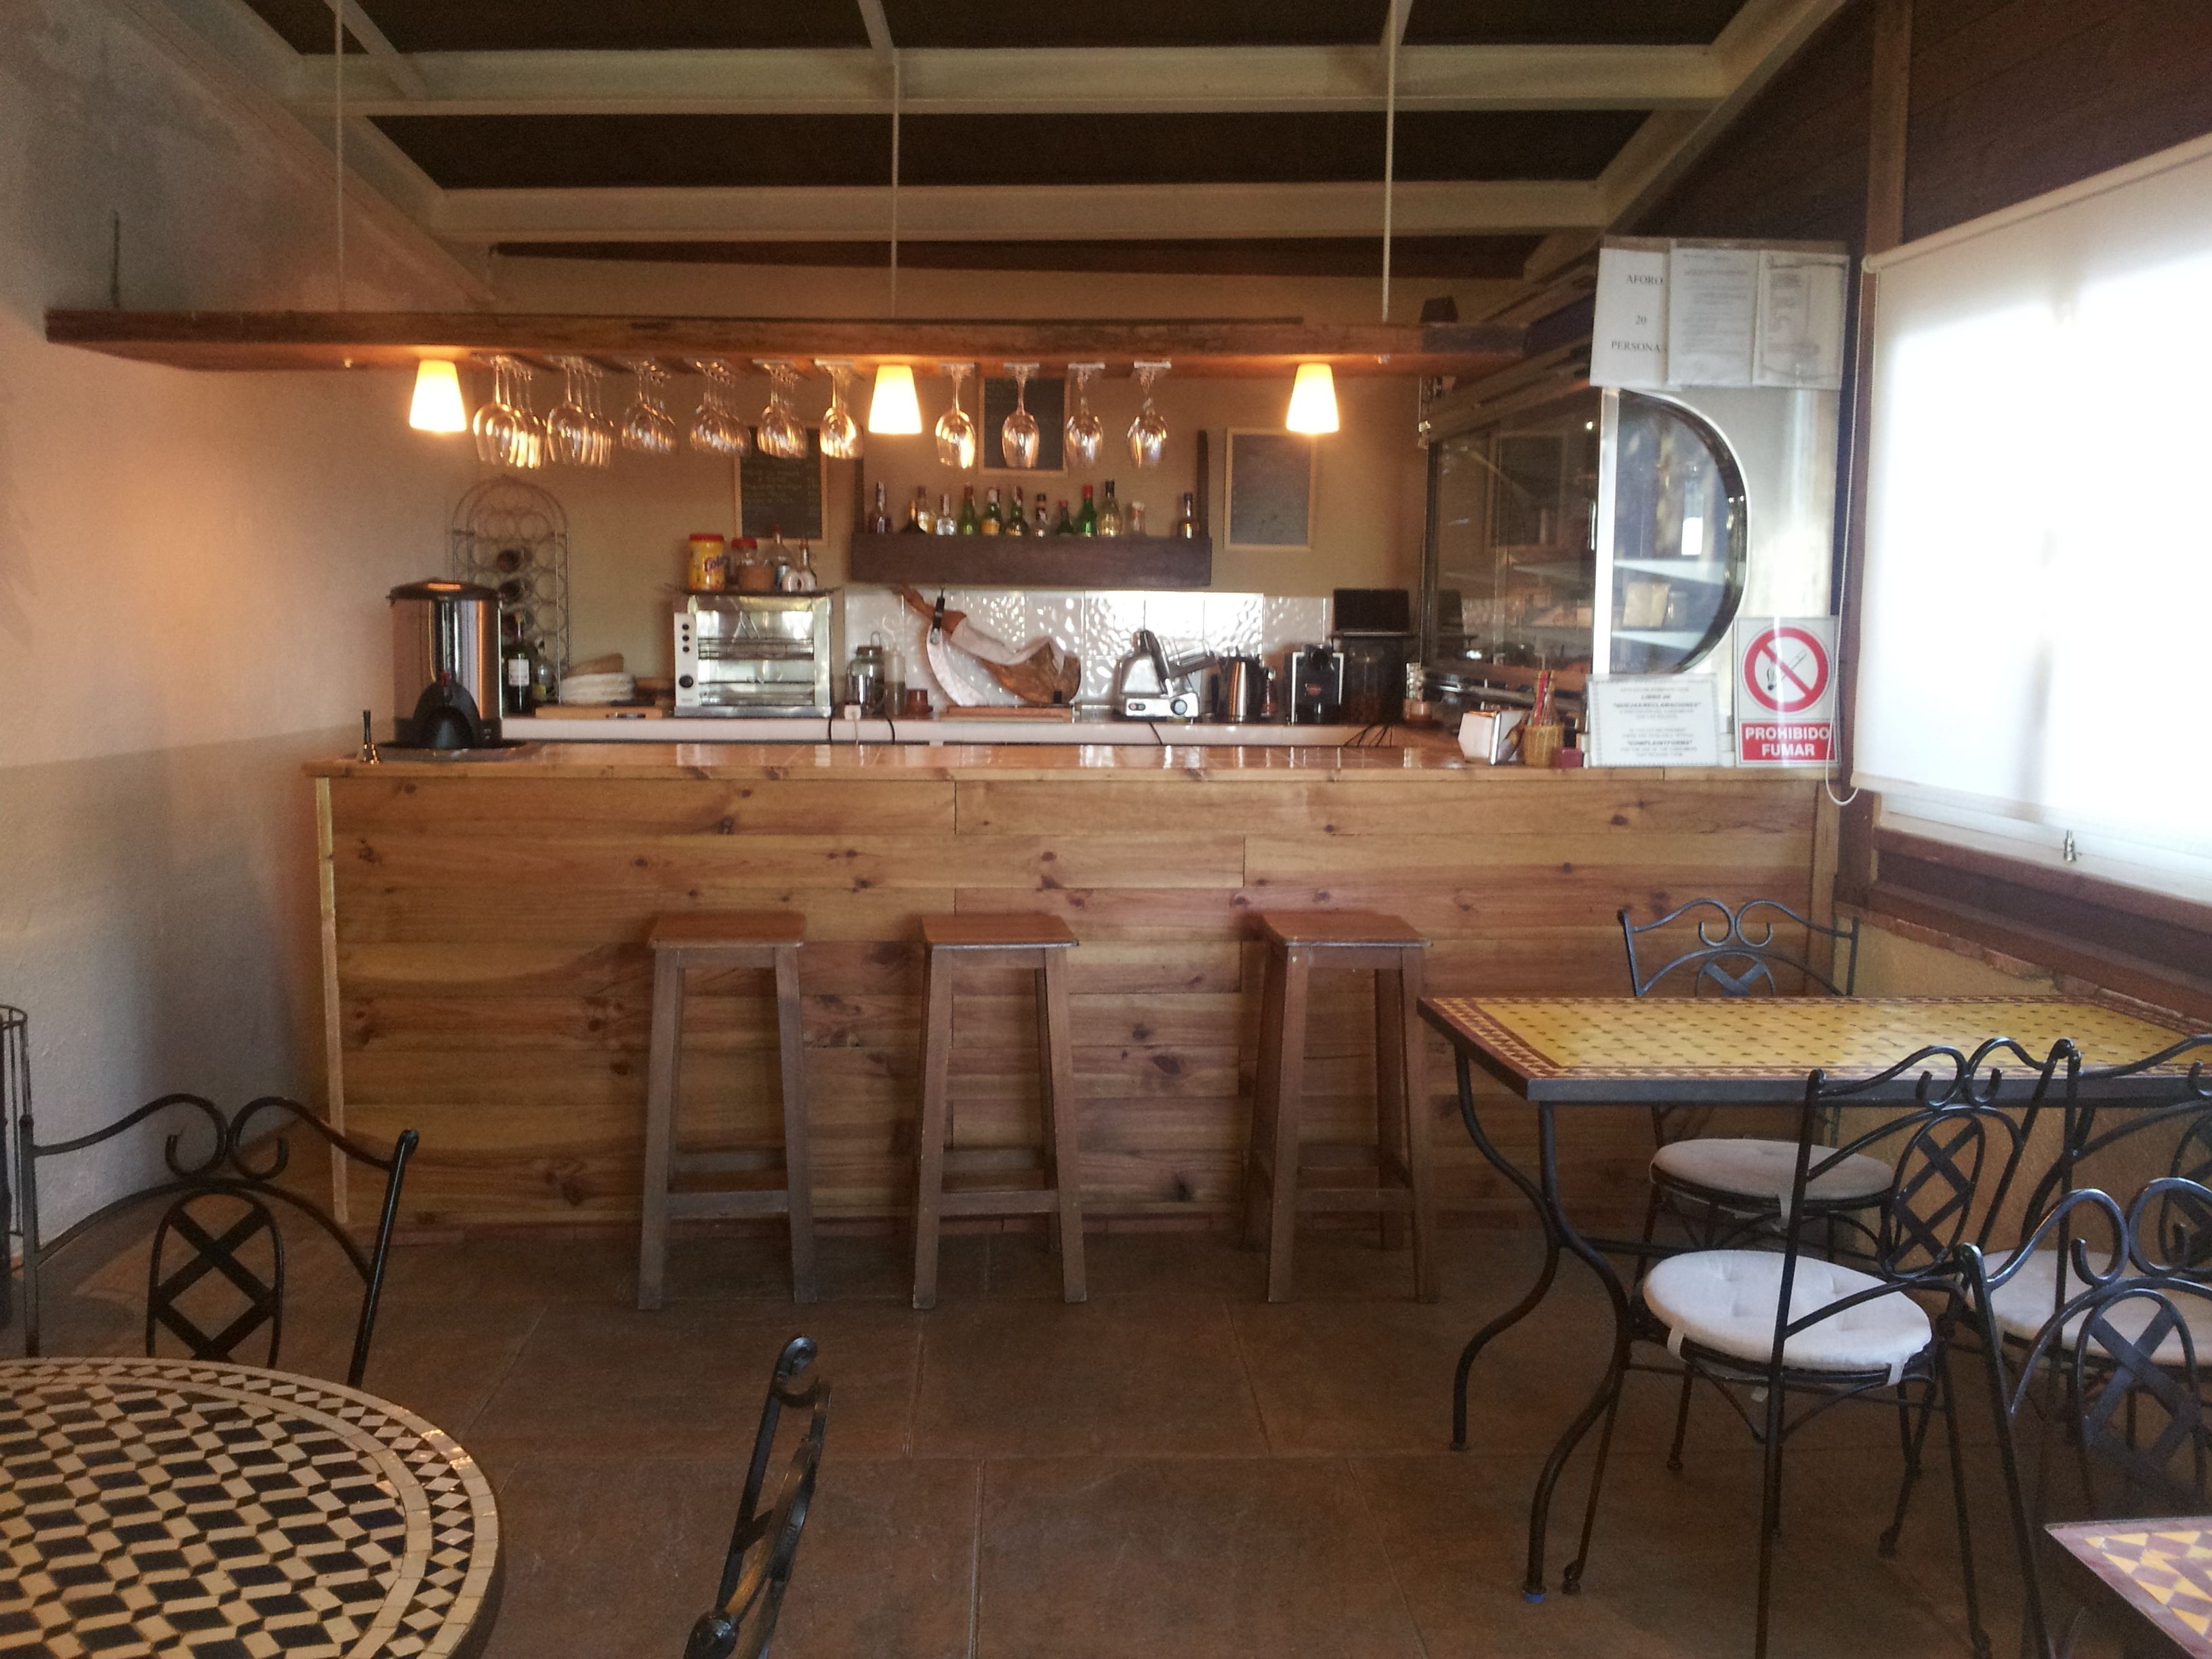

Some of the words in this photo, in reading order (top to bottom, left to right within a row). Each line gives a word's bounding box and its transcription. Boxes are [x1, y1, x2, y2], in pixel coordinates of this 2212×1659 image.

[1627, 274, 1663, 285] AFORO
[1635, 314, 1647, 325] 20
[1745, 726, 1830, 740] PROHIBIDO
[1762, 743, 1815, 756] FUMAR
